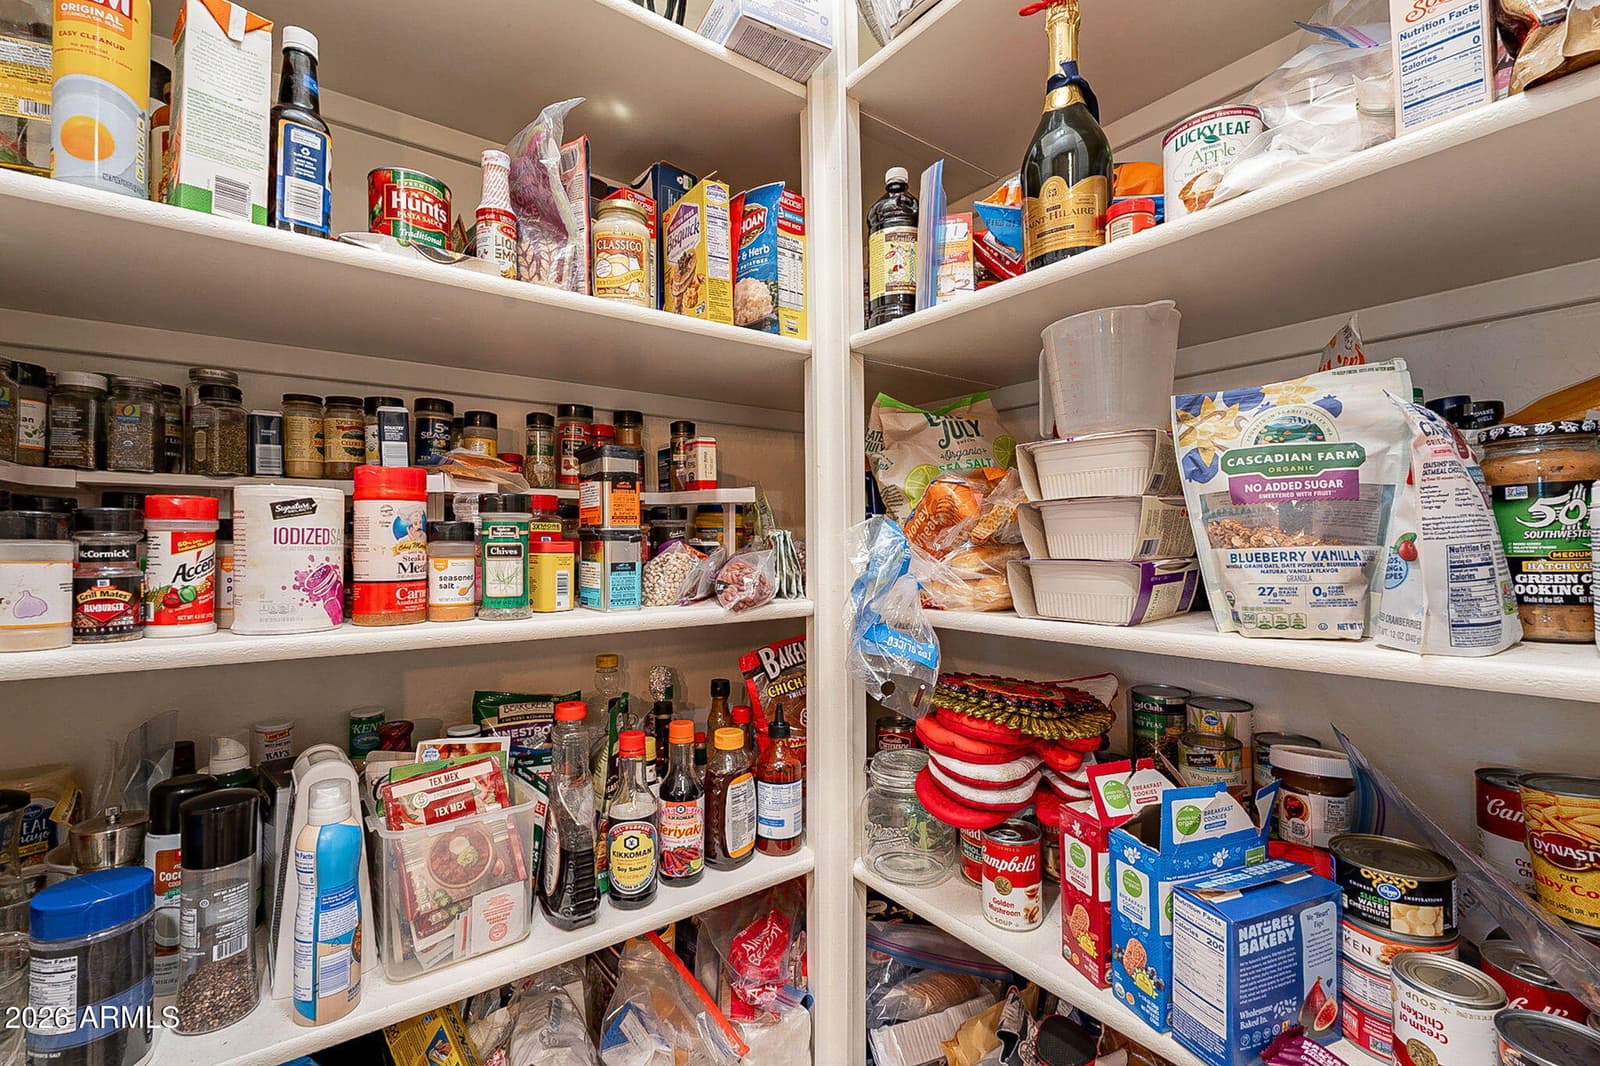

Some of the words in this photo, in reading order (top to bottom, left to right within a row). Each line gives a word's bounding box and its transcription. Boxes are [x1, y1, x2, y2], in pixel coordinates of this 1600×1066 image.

[60, 3, 125, 26] ORIGINAL
[1399, 16, 1445, 42] Nutrition
[1448, 3, 1480, 21] Facts
[79, 32, 126, 52] CLEANUP
[1402, 54, 1438, 73] Calories
[1472, 34, 1480, 45] 0
[1174, 123, 1217, 152] LUCKY
[1218, 120, 1251, 136] LEAF
[1189, 142, 1236, 167] Apple
[403, 181, 439, 196] PREMIUM
[391, 190, 448, 223] Hunt's
[397, 209, 421, 221] PASTA
[422, 215, 443, 229] SAUCE
[741, 212, 765, 233] HOAN
[399, 228, 442, 246] Traditional
[666, 220, 701, 252] Bisquick
[597, 239, 643, 251] CLASSICO
[749, 244, 770, 257] Herb
[938, 417, 983, 449] JULY
[966, 457, 992, 468] SALT
[1226, 452, 1312, 468] CASCADIAN
[1317, 450, 1359, 460] FARM
[1267, 465, 1316, 473] ORGANIC
[1244, 483, 1263, 493] NO
[1264, 481, 1304, 492] ADDED
[1305, 479, 1344, 489] SUGAR
[273, 526, 330, 545] IODIZED
[1523, 529, 1593, 541] SOUTHWESTER
[490, 547, 518, 555] Chives
[1230, 551, 1306, 563] BLUEBERRY
[1311, 550, 1361, 562] VANILLA
[398, 562, 425, 575] Mea
[1528, 562, 1571, 571] HATCH
[438, 574, 473, 582] seasoned
[1286, 575, 1312, 583] GRANOLA
[1515, 574, 1583, 584] GREEN
[395, 586, 425, 601] Carn
[438, 582, 454, 590] salt
[1515, 585, 1584, 596] OOKING
[79, 590, 98, 602] Grill
[100, 590, 129, 600] Mates
[84, 602, 125, 613] HAMBURGER
[429, 776, 443, 787] TEX
[444, 772, 460, 783] MEX
[1132, 782, 1162, 792] BREAKFAST
[1133, 789, 1158, 798] COOKIES
[434, 806, 449, 818] TEX
[449, 801, 467, 813] MEX
[1203, 805, 1233, 817] BREAKFAST
[1203, 813, 1227, 823] COOKIES
[22, 818, 48, 834] EAL
[660, 823, 702, 839] Teriyaki
[612, 847, 652, 858] KIKKOMAN
[981, 846, 1036, 873] Campbell's
[628, 864, 647, 872] Sauce
[1559, 873, 1579, 883] CUT
[1359, 891, 1390, 905] SLICED
[1571, 886, 1600, 900] Co
[988, 902, 1021, 917] Mushroom
[992, 896, 1014, 909] Golden
[1348, 899, 1390, 919] CHESTNUTS
[1357, 897, 1390, 913] WATER
[1174, 895, 1200, 915] Nutrition
[1203, 912, 1222, 928] Facts
[994, 916, 1013, 927] SOUP
[1238, 914, 1295, 942] NATURE'S
[1174, 918, 1199, 939] Calories
[1206, 937, 1225, 953] 200
[1239, 928, 1295, 957] BAKERY
[1406, 990, 1437, 1011] SOUP
[1239, 1004, 1273, 1020] Wholesome
[1399, 1000, 1444, 1031] Chicken
[1239, 1018, 1257, 1031] Baked
[1410, 1019, 1448, 1044] Cream
